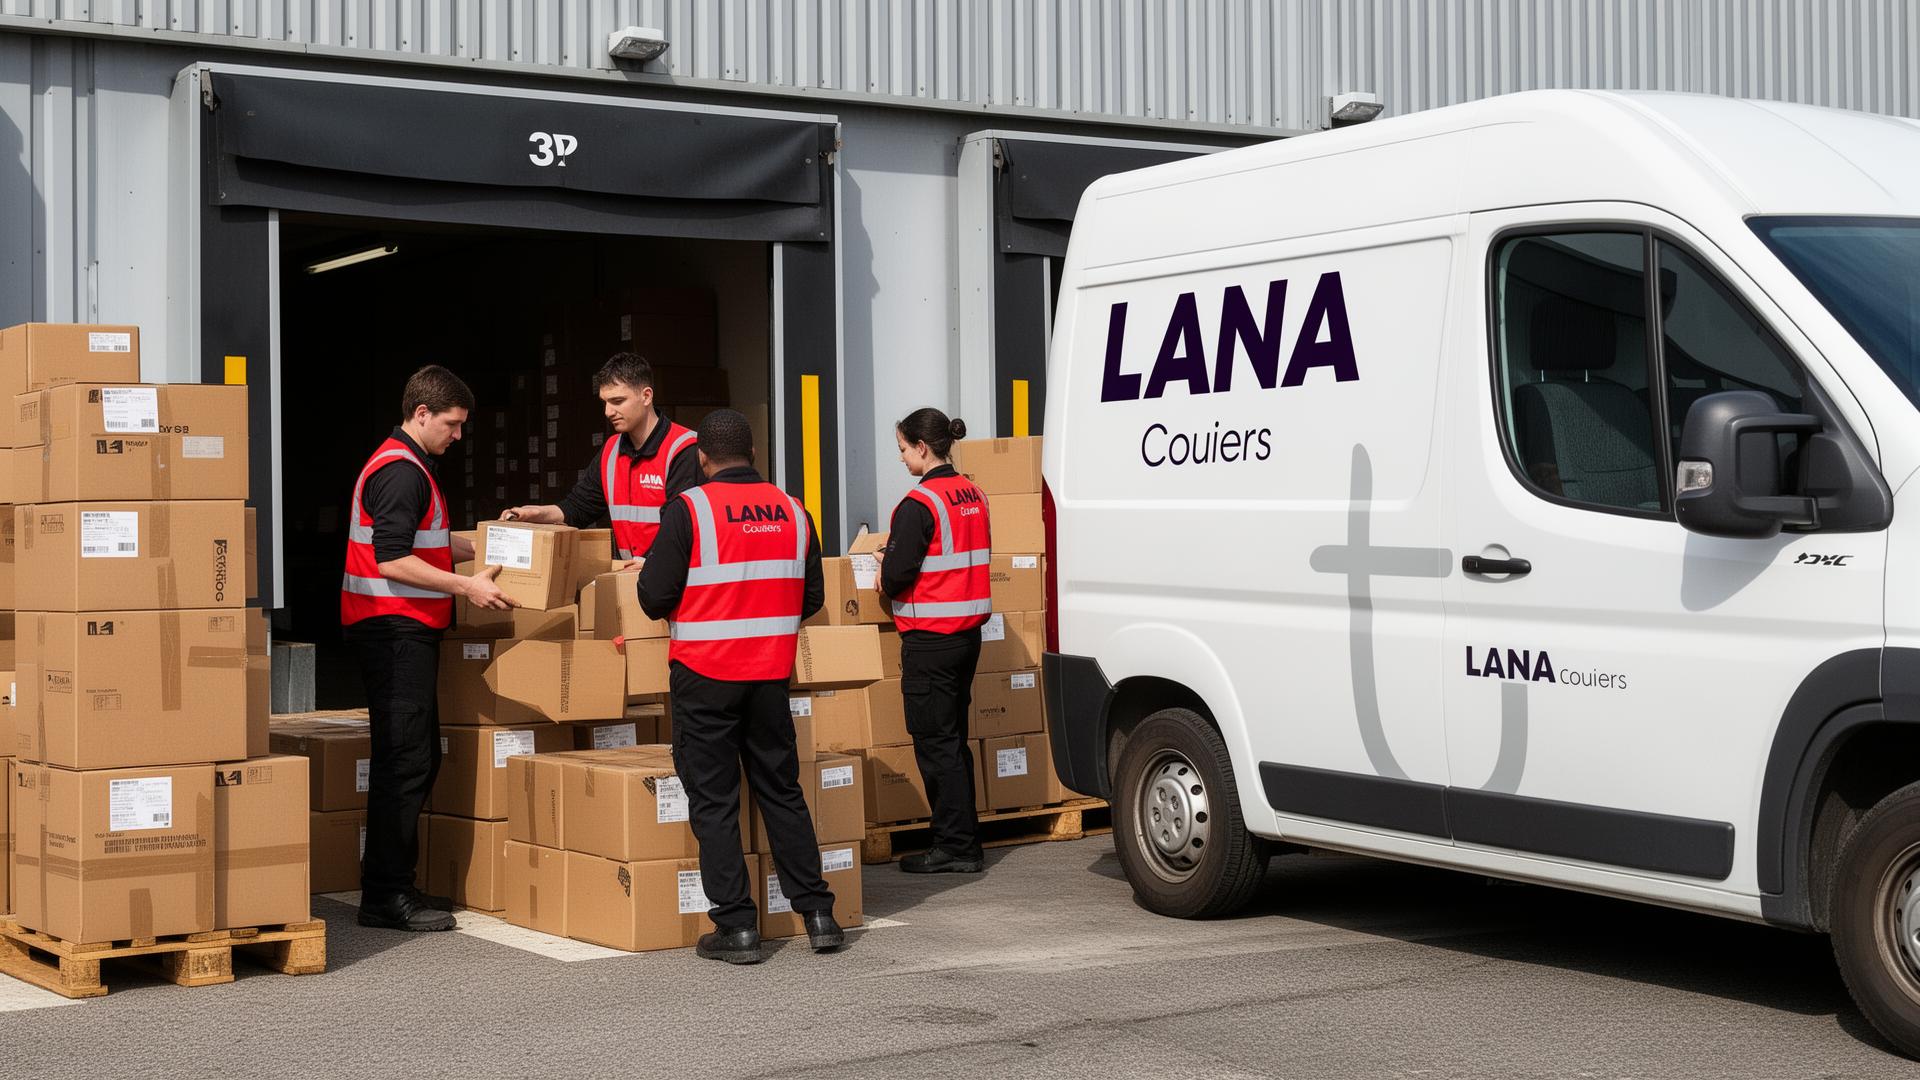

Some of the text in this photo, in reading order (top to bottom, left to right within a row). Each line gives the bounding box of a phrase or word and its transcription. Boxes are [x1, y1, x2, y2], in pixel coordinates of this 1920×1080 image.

[1101, 271, 1360, 402] LANA
[1141, 421, 1272, 467] Couiers
[640, 473, 664, 486] LANA
[945, 487, 982, 507] LANA
[725, 504, 789, 523] LANA
[1466, 645, 1628, 690] LANA Couiers
